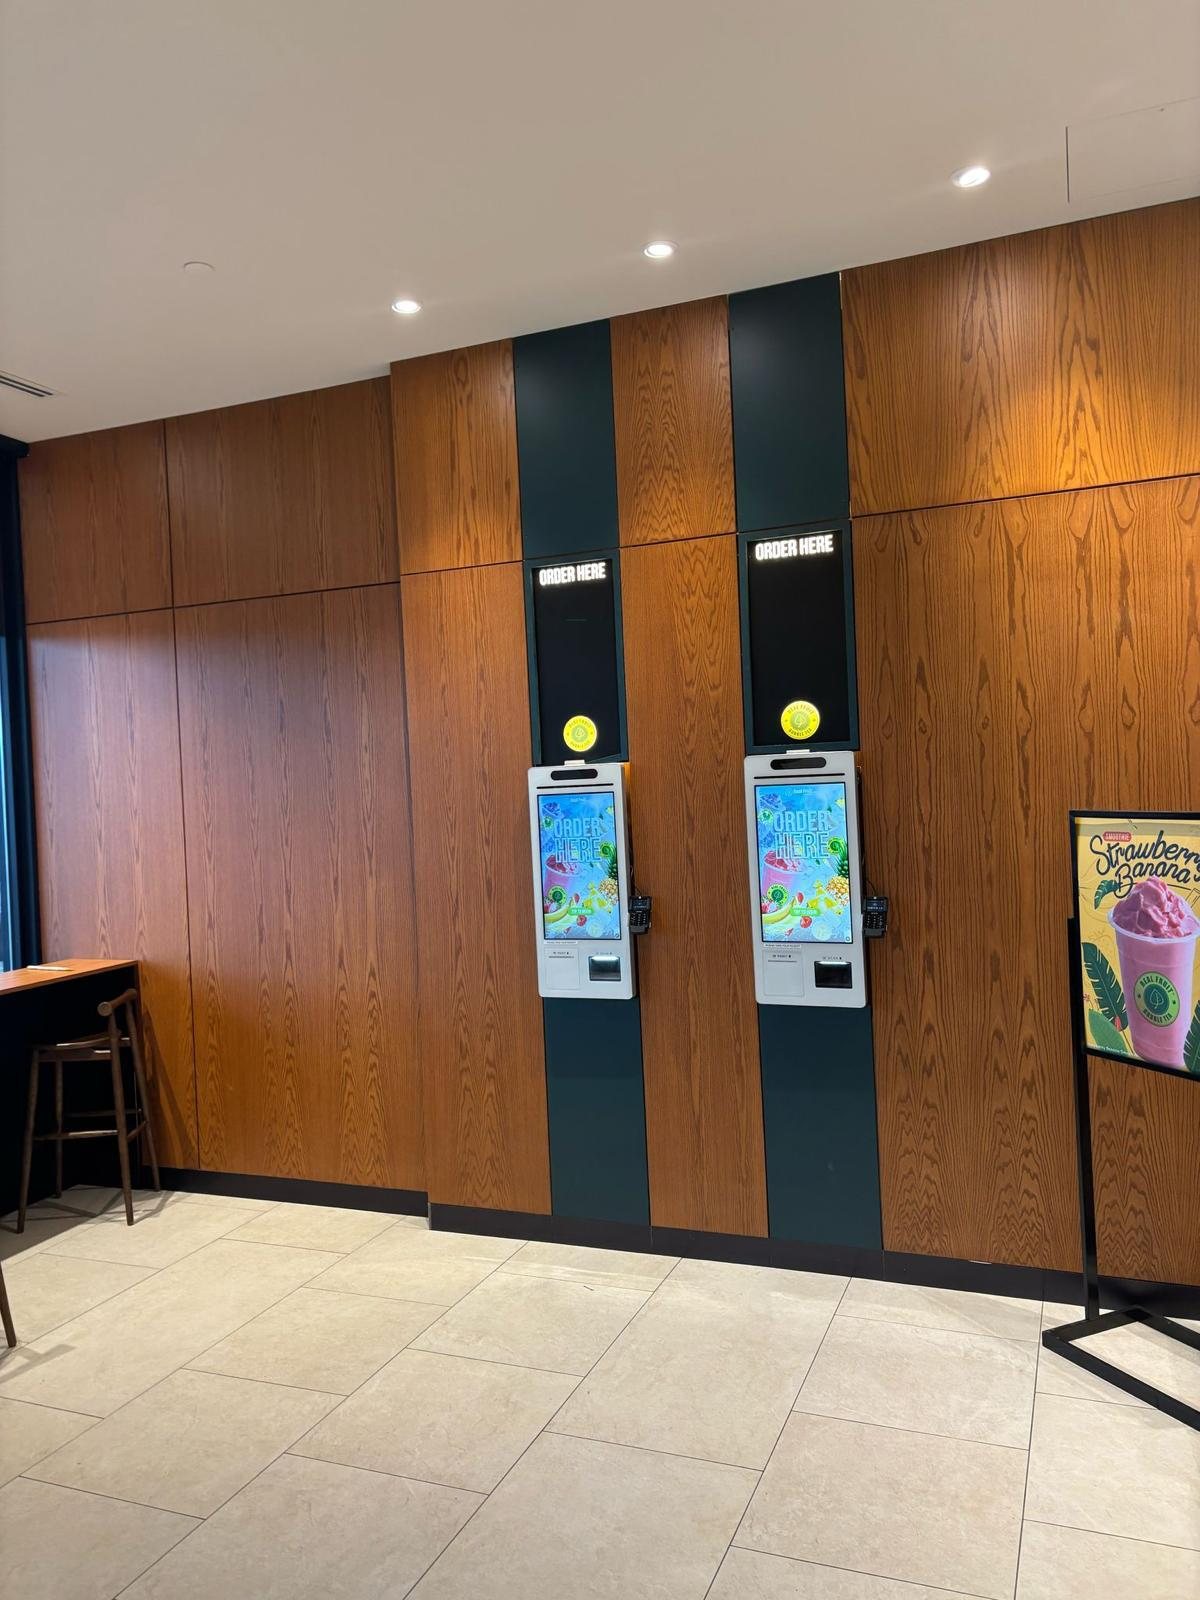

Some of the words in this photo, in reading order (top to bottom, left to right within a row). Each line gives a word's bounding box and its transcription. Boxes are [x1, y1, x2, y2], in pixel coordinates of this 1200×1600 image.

[755, 539, 797, 560] ORDER
[799, 534, 834, 555] HERE
[539, 565, 575, 586] ORDER
[576, 562, 606, 581] HERE
[554, 817, 602, 838] ORDER
[773, 810, 831, 832] ORDER
[554, 837, 602, 863] HERE
[775, 832, 830, 859] HERE
[1114, 861, 1191, 898] Banana
[1140, 976, 1154, 988] REAL
[1155, 976, 1174, 993] FRUIT
